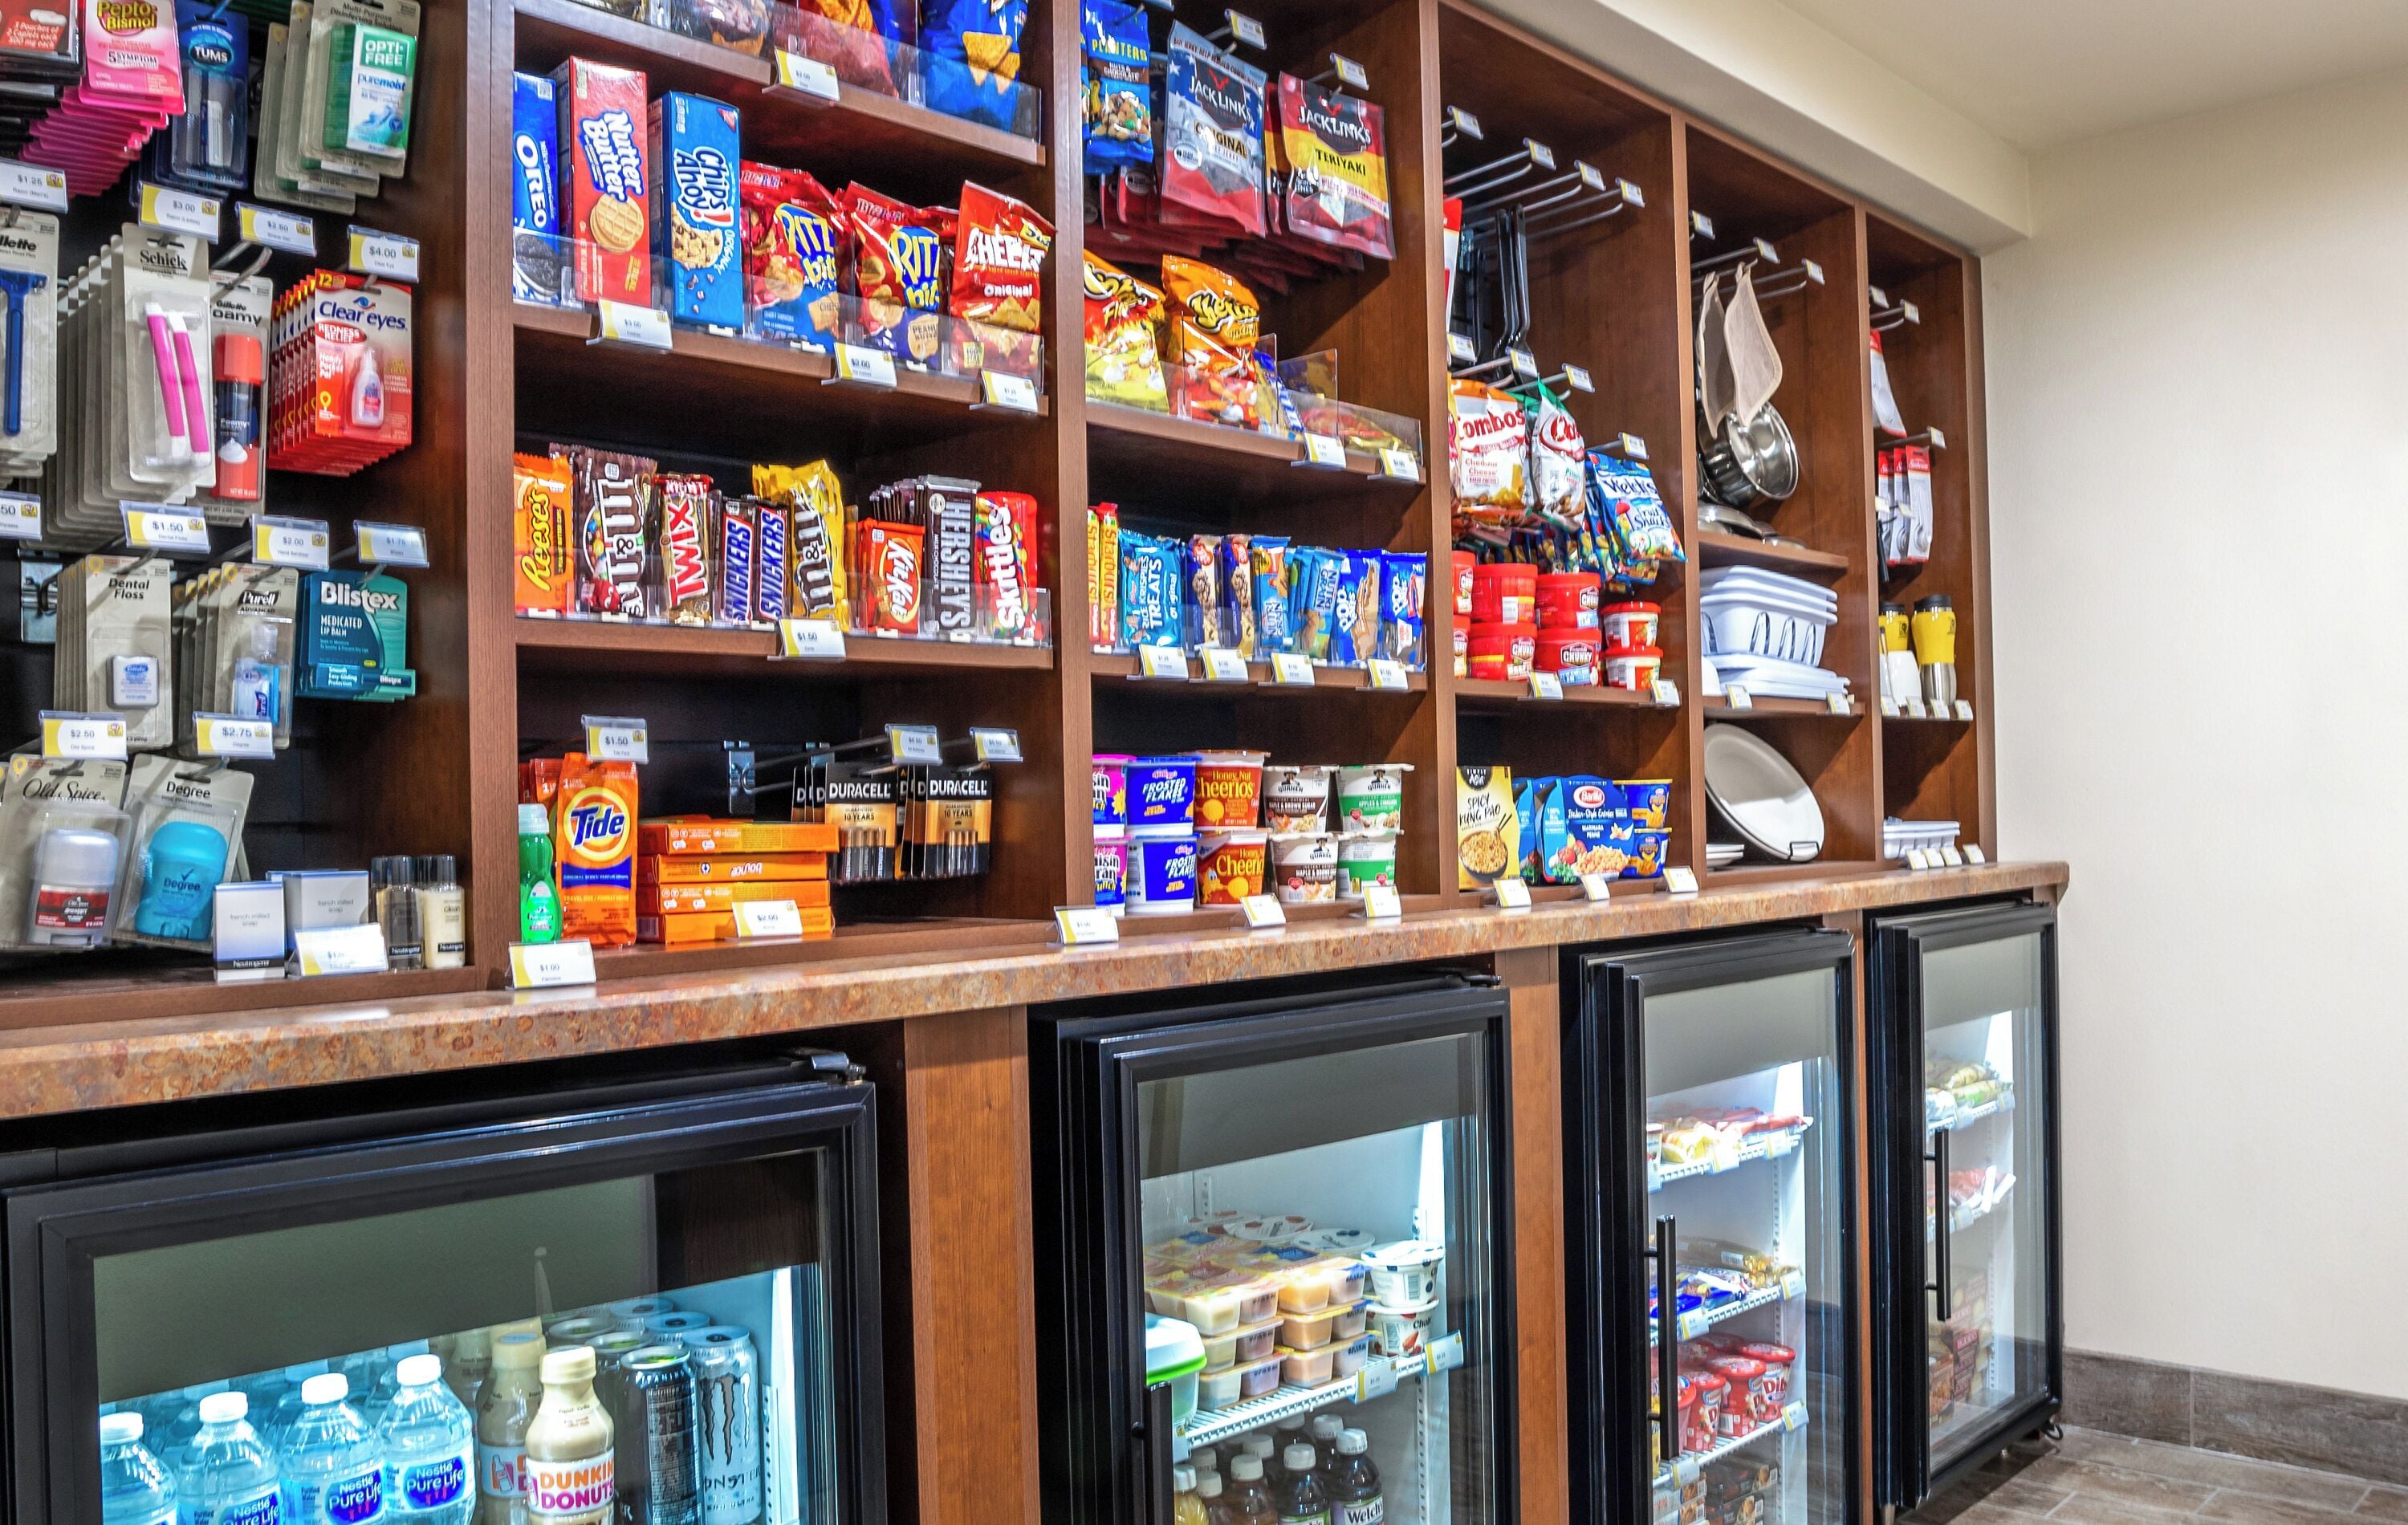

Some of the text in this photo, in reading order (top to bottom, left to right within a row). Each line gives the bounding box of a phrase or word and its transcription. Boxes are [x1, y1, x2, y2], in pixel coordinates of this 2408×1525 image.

[107, 14, 157, 31] Bismol
[108, 51, 157, 64] 5 SYMPTOM
[195, 47, 228, 63] TUMS
[365, 53, 403, 67] FREE
[357, 73, 406, 92] puremoist
[1189, 75, 1218, 108] JACK
[1299, 105, 1334, 135] JACK
[582, 118, 628, 203] Butter
[603, 109, 644, 196] Nutter
[1315, 148, 1366, 176] TERIYAKI
[515, 134, 547, 229] OREO
[173, 201, 196, 213] $3.00
[140, 250, 188, 270] Schick
[369, 247, 397, 259] $4.00
[319, 273, 332, 287] 12
[984, 283, 1033, 298] Original
[319, 301, 405, 331] Clear eyes
[318, 323, 360, 338] REDNESS
[324, 330, 353, 344] RELIEF
[221, 418, 247, 429] Foamy
[1601, 476, 1658, 496] Welch's
[153, 520, 184, 532] $1.50
[283, 535, 304, 547] $2.00
[522, 490, 551, 591] Reese's
[667, 499, 709, 608] TWIX
[725, 519, 751, 624] SNICKERS
[761, 509, 785, 620] SNICKERS
[941, 501, 971, 628] HERSHEY'S
[108, 578, 150, 591] Dental
[1140, 555, 1149, 605] KRISPIES
[114, 588, 144, 600] Floss
[321, 580, 399, 614] Blistex
[1148, 559, 1163, 629] TREATS
[1317, 568, 1327, 610] GRAIN
[1324, 569, 1337, 611] NUTRI
[242, 590, 277, 607] Purell
[321, 614, 363, 629] MEDICATED
[1264, 602, 1275, 638] NUTRI
[1275, 601, 1285, 637] GRAIN
[321, 626, 348, 637] LIP BALM
[1564, 650, 1593, 665] CHUNKY
[70, 729, 96, 738] $2.50
[222, 726, 252, 738] $2.75
[605, 735, 628, 746] $1.50
[1212, 770, 1251, 782] Honey Nut
[22, 779, 103, 801] Old Spice
[165, 781, 211, 799] Degree
[829, 783, 889, 799] DURACELL
[930, 779, 986, 796] DURACELL
[1142, 777, 1186, 794] FROSTED
[1194, 777, 1254, 799] Cheerios
[1278, 785, 1304, 794] QUAKER
[1367, 783, 1391, 791] QUAKER
[1146, 787, 1183, 803] FLAKES
[1467, 791, 1491, 811] SPICY
[1581, 790, 1603, 803] Barilla
[844, 812, 875, 823] 10 YEARS
[944, 808, 973, 818] 10 YEARS
[1458, 803, 1501, 828] KUNG PAO
[571, 805, 625, 849] Tide
[1239, 848, 1259, 859] Honey
[163, 876, 201, 892] Degree
[407, 1468, 465, 1493] Pure Life
[329, 1482, 383, 1511] Pure Life
[261, 1505, 280, 1525] Life
